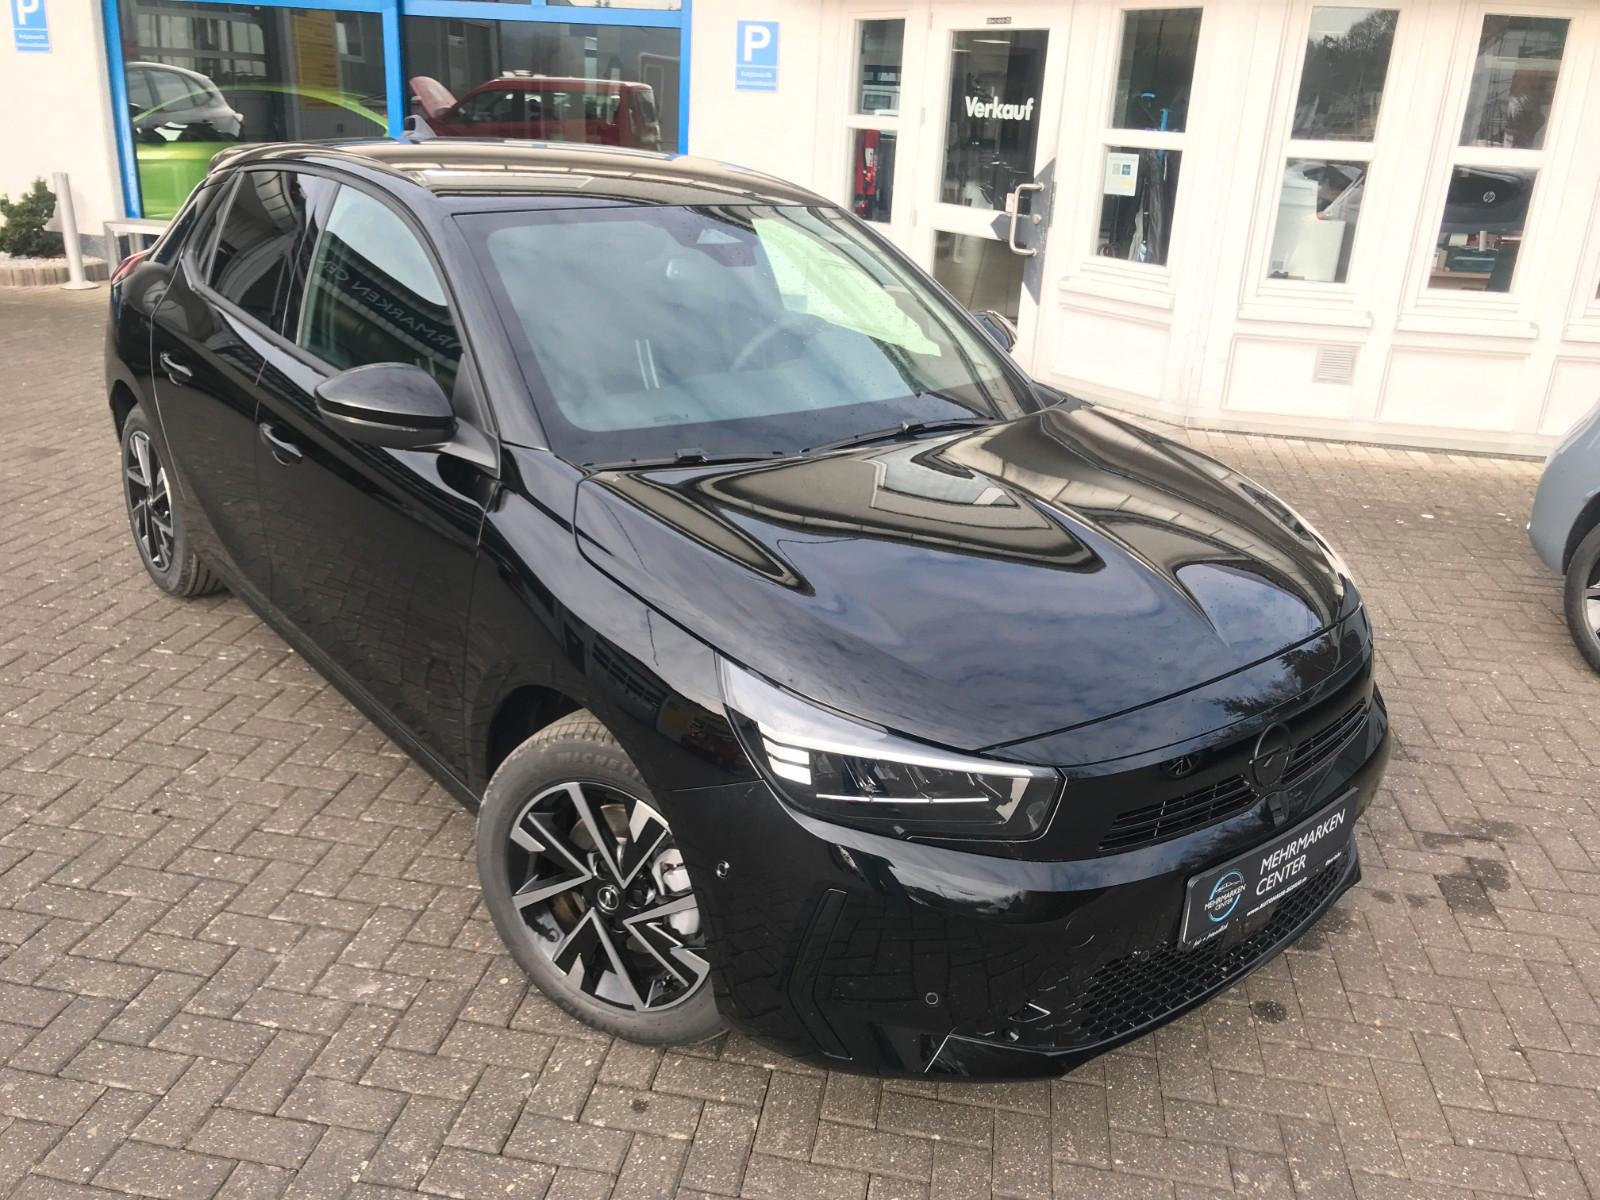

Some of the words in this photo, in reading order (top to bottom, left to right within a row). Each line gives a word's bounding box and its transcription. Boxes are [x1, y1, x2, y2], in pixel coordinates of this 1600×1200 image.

[744, 25, 771, 61] P
[965, 96, 1034, 120] Verkauf
[1260, 808, 1346, 875] MEHRMARKEN
[1256, 854, 1307, 896] CENTER
[1204, 883, 1247, 911] MEHRMARKEN
